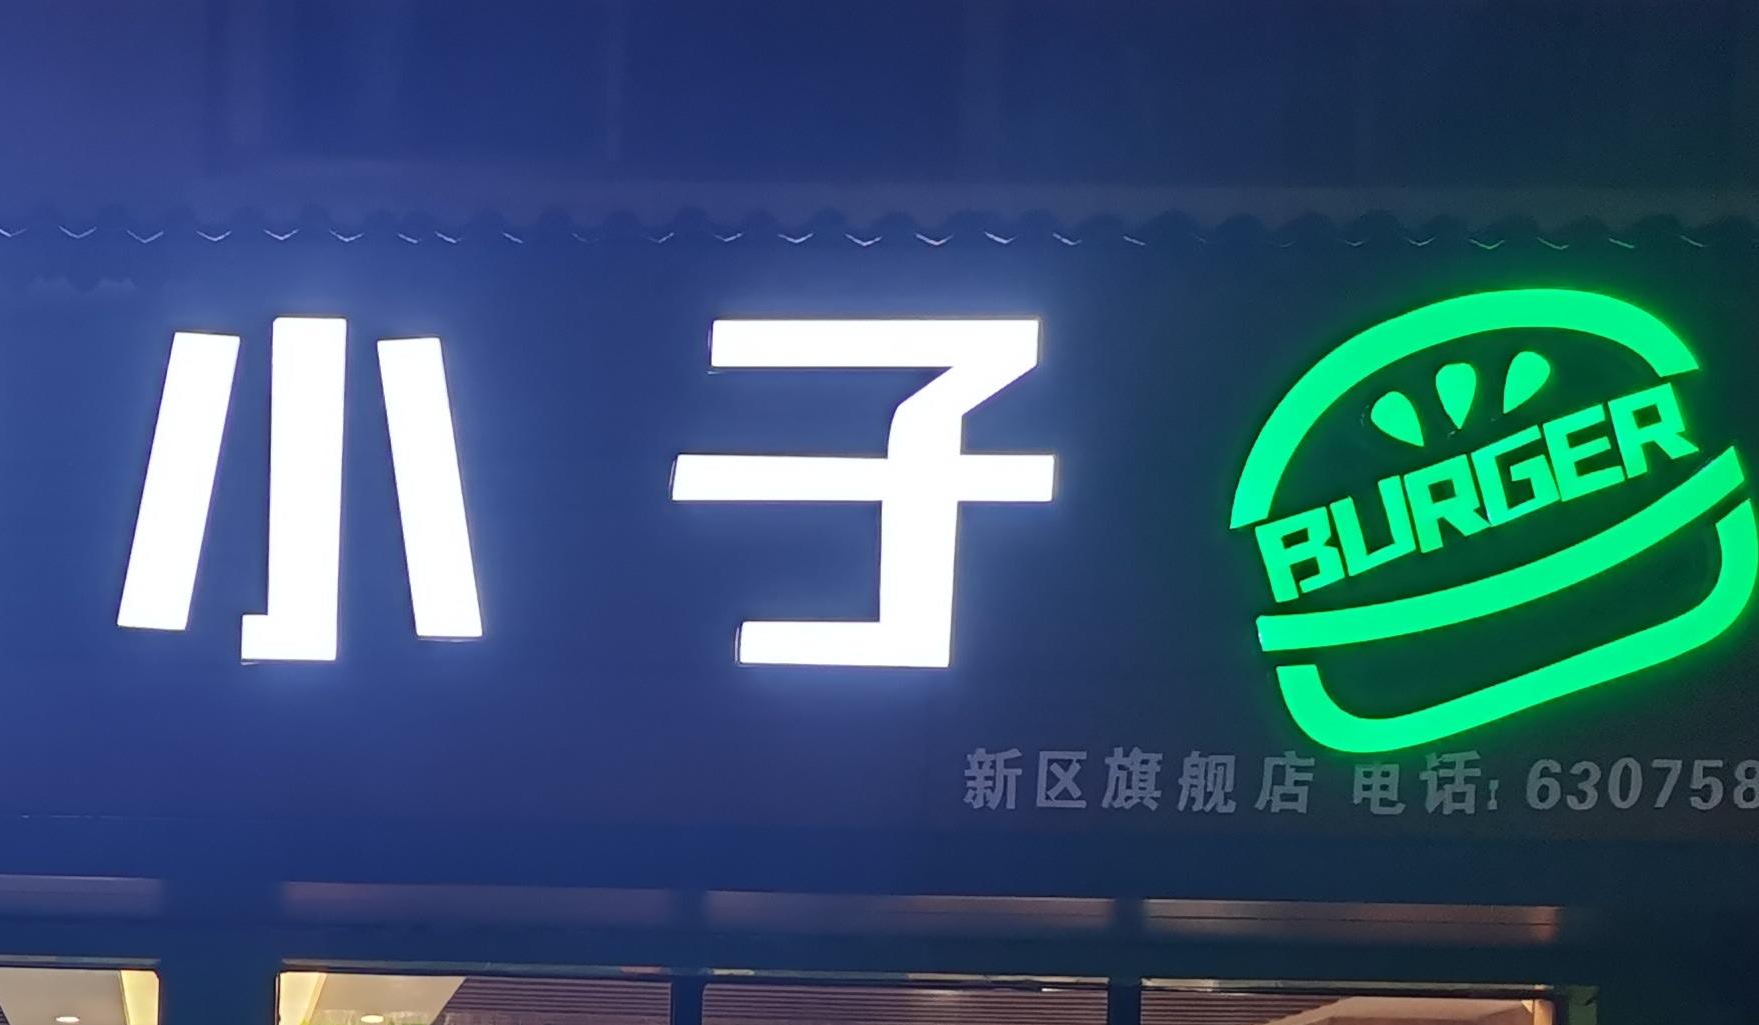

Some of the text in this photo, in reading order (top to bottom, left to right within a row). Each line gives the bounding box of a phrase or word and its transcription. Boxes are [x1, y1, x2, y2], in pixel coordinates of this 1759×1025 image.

[1256, 382, 1699, 603] BURGER
[963, 748, 1314, 814] 新区旗舰店
[1526, 756, 1759, 811] 630758
